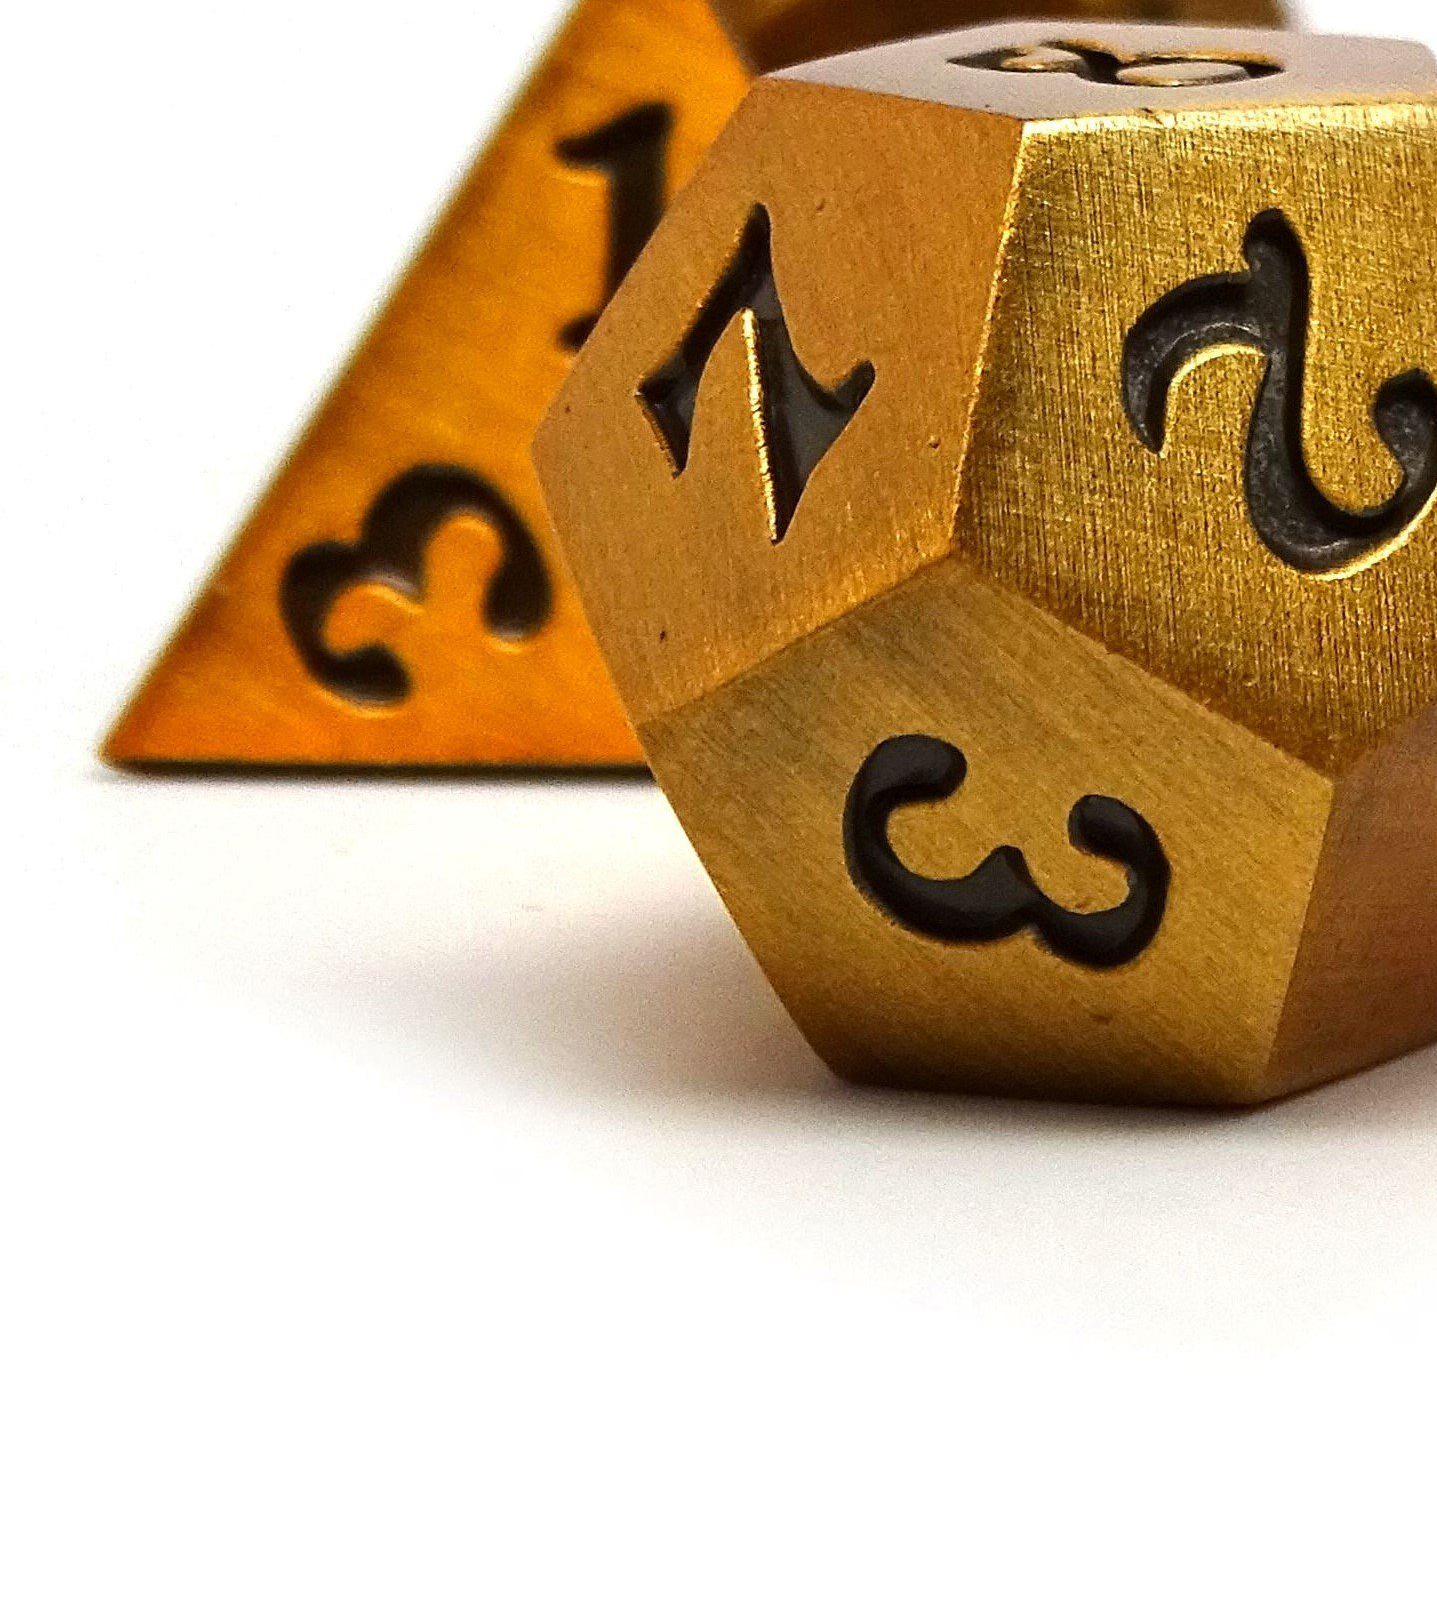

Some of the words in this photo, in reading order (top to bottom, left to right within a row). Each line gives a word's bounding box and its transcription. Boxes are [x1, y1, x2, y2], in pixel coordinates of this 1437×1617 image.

[946, 38, 1286, 87] 8
[556, 99, 672, 355] 1
[636, 201, 876, 543] 7
[278, 461, 556, 707] 3
[843, 733, 1171, 971] 3
